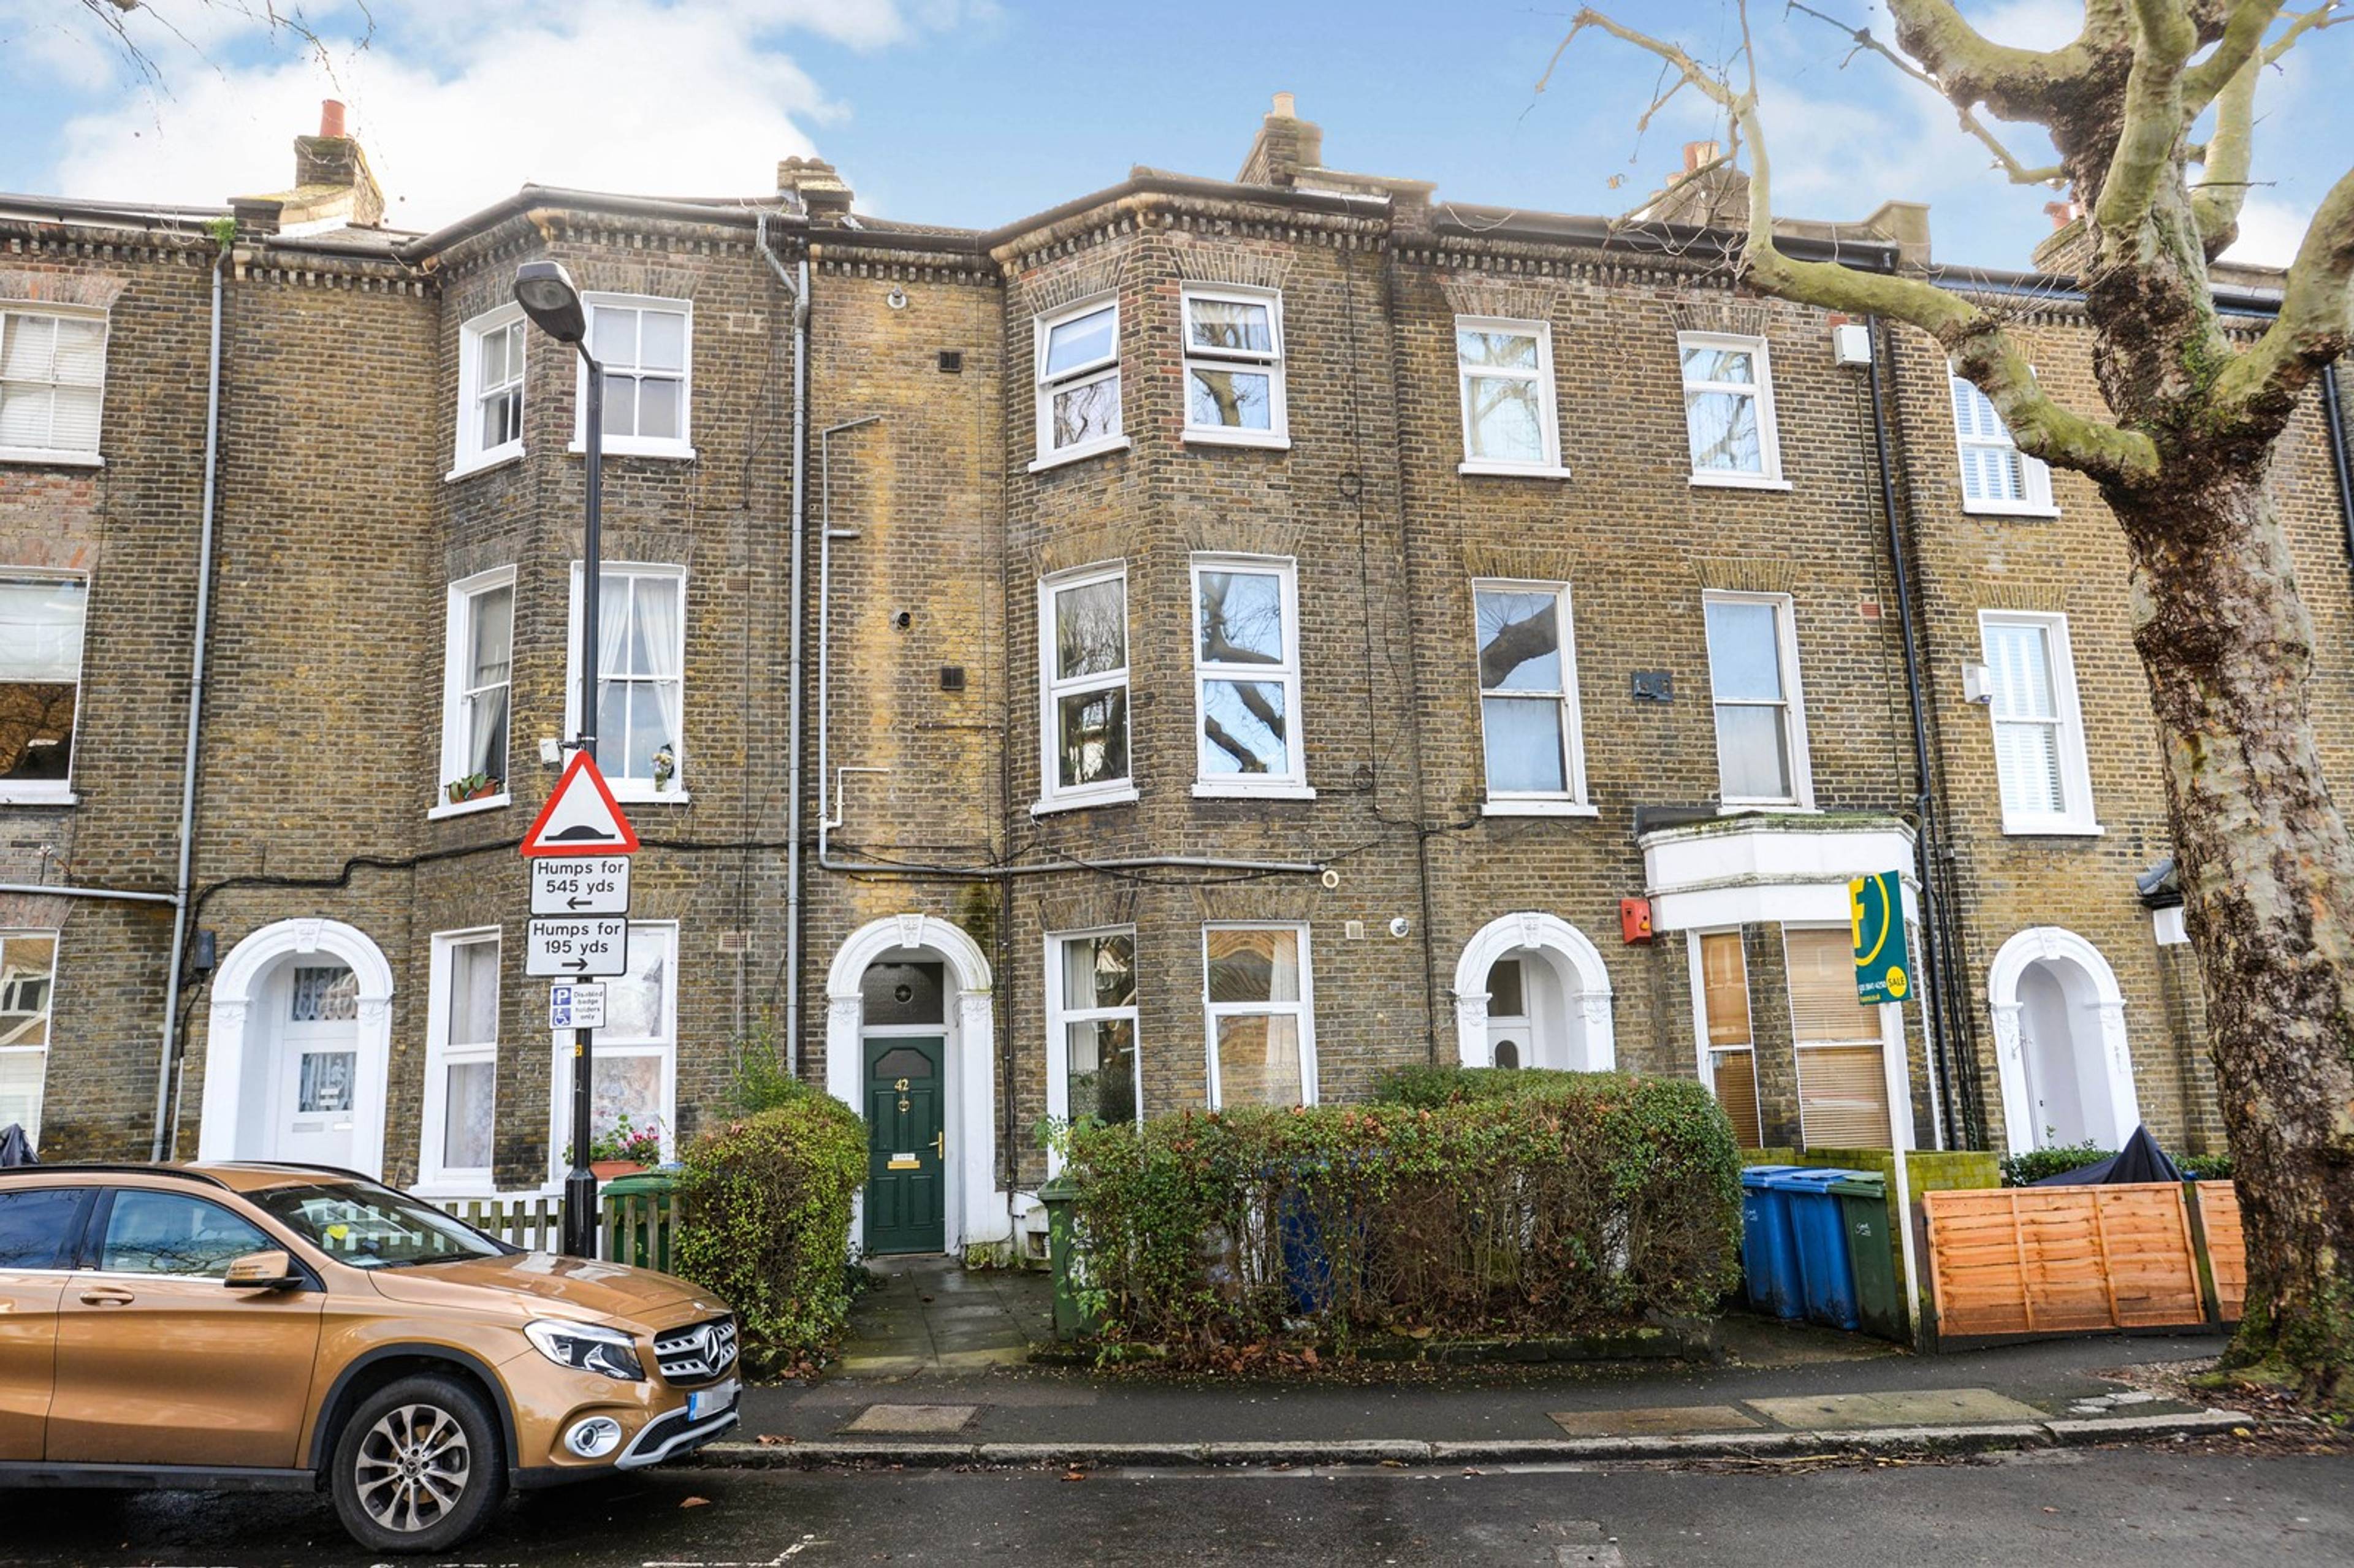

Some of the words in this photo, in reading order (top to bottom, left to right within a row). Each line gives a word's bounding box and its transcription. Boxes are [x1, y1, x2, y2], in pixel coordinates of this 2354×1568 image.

[538, 862, 593, 876] Humps
[601, 861, 624, 873] for
[546, 880, 579, 893] 545
[587, 880, 614, 895] yds
[533, 923, 589, 938] Humps
[598, 923, 620, 935] for
[544, 940, 572, 954] 195
[580, 940, 609, 955] yds
[1888, 976, 1905, 988] SALE
[557, 989, 569, 1004] P
[894, 1078, 910, 1091] 42
